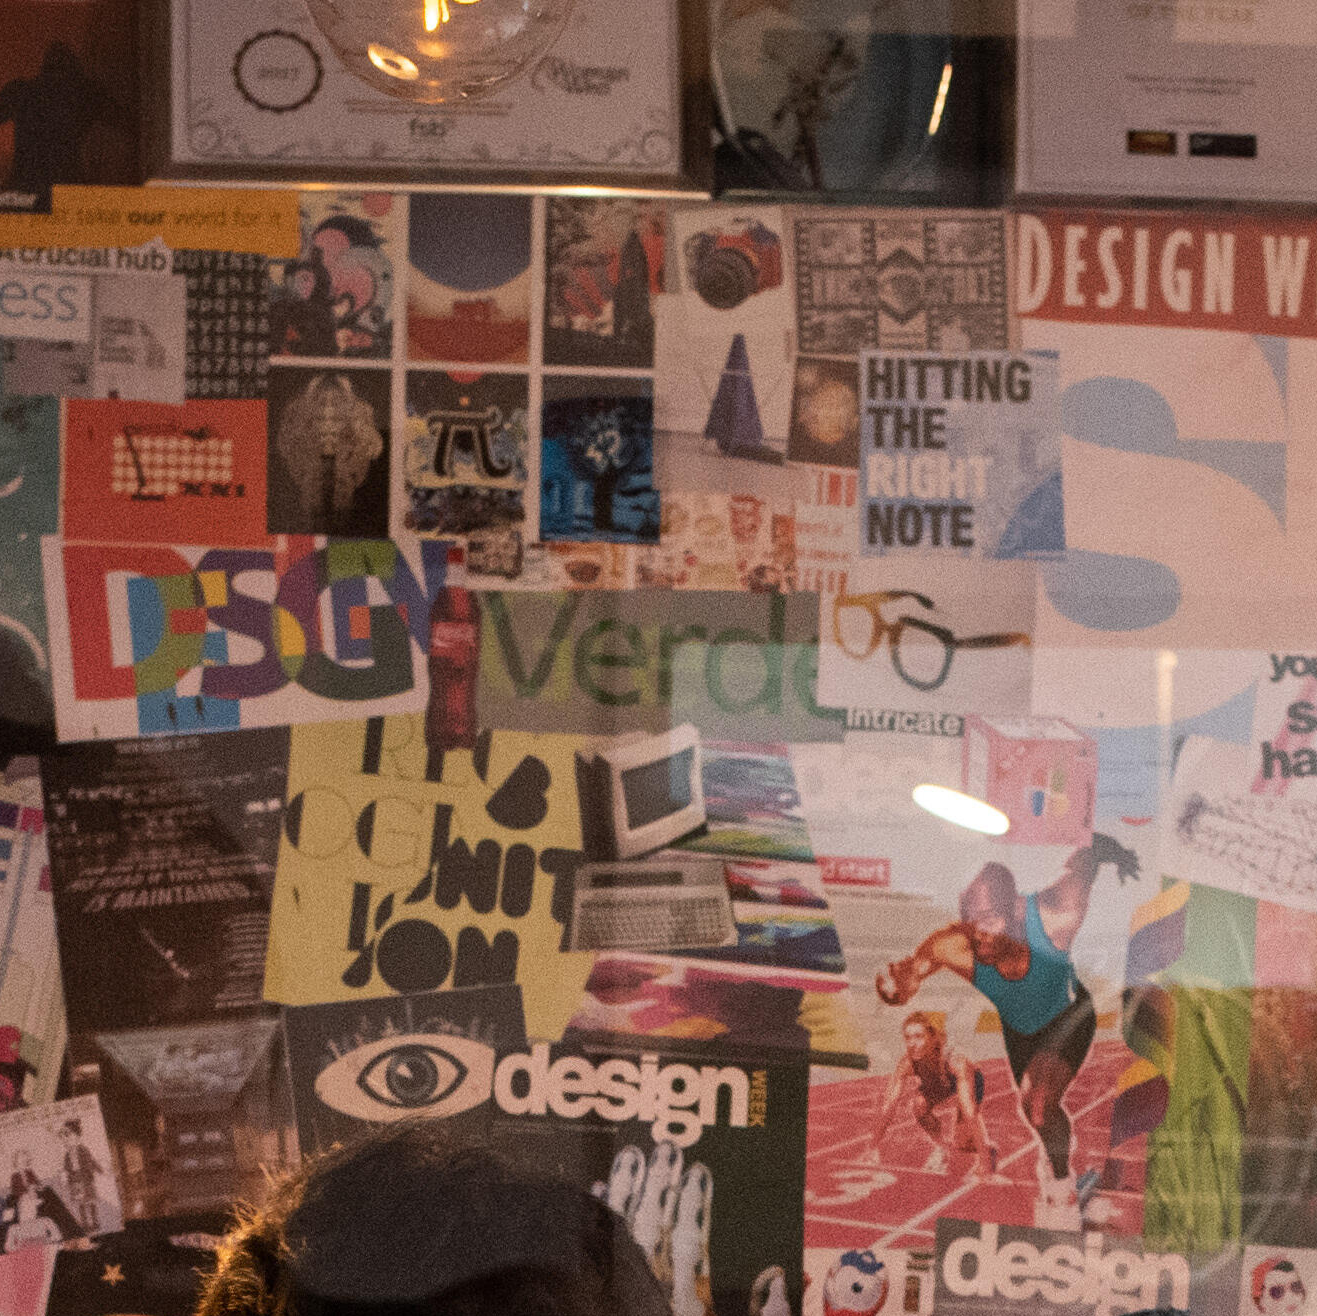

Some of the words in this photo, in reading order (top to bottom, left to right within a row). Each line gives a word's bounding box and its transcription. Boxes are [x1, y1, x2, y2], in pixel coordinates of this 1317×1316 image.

[127, 211, 164, 226] our
[174, 210, 225, 227] word
[233, 209, 261, 226] for
[117, 247, 166, 271] hub
[1017, 215, 1233, 314] DESIGN
[867, 357, 1032, 403] HITTING
[868, 406, 948, 449] THE
[867, 455, 993, 499] RIGHT
[867, 504, 975, 548] NOTE
[493, 1044, 750, 1147] design
[749, 1070, 767, 1128] WEEK
